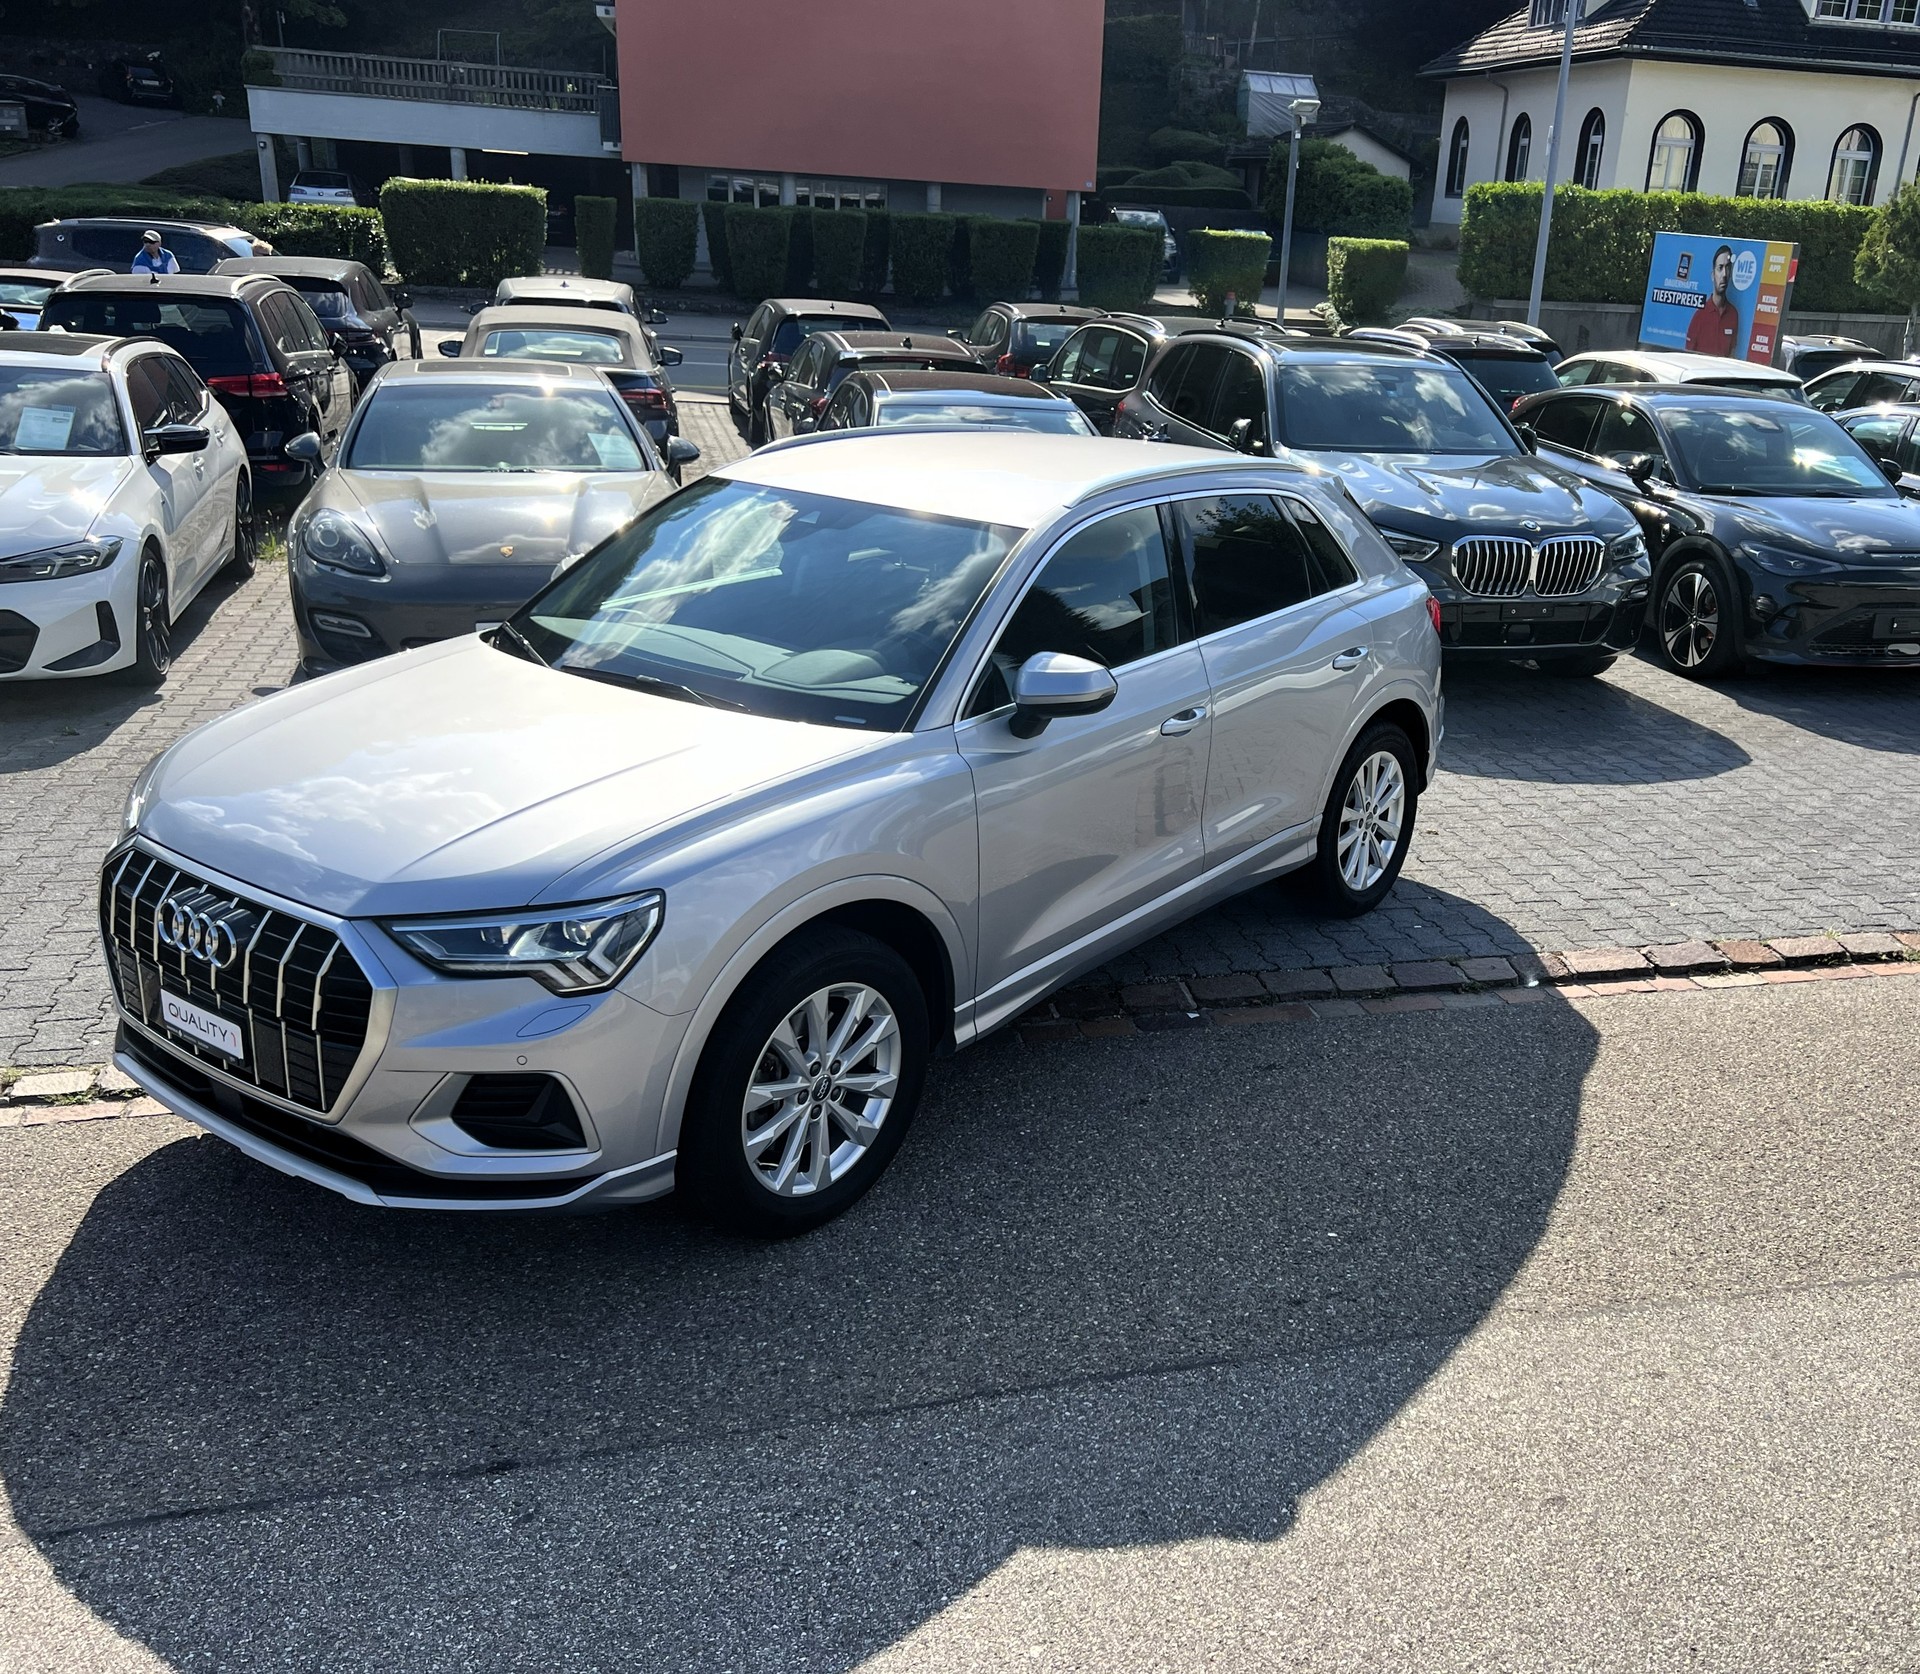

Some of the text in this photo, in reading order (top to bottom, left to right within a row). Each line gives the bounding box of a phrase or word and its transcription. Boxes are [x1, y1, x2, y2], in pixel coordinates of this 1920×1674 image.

[1737, 260, 1754, 274] WIE
[1653, 289, 1705, 308] TIEFSTPREISE.
[168, 1003, 228, 1042] QUALITY
